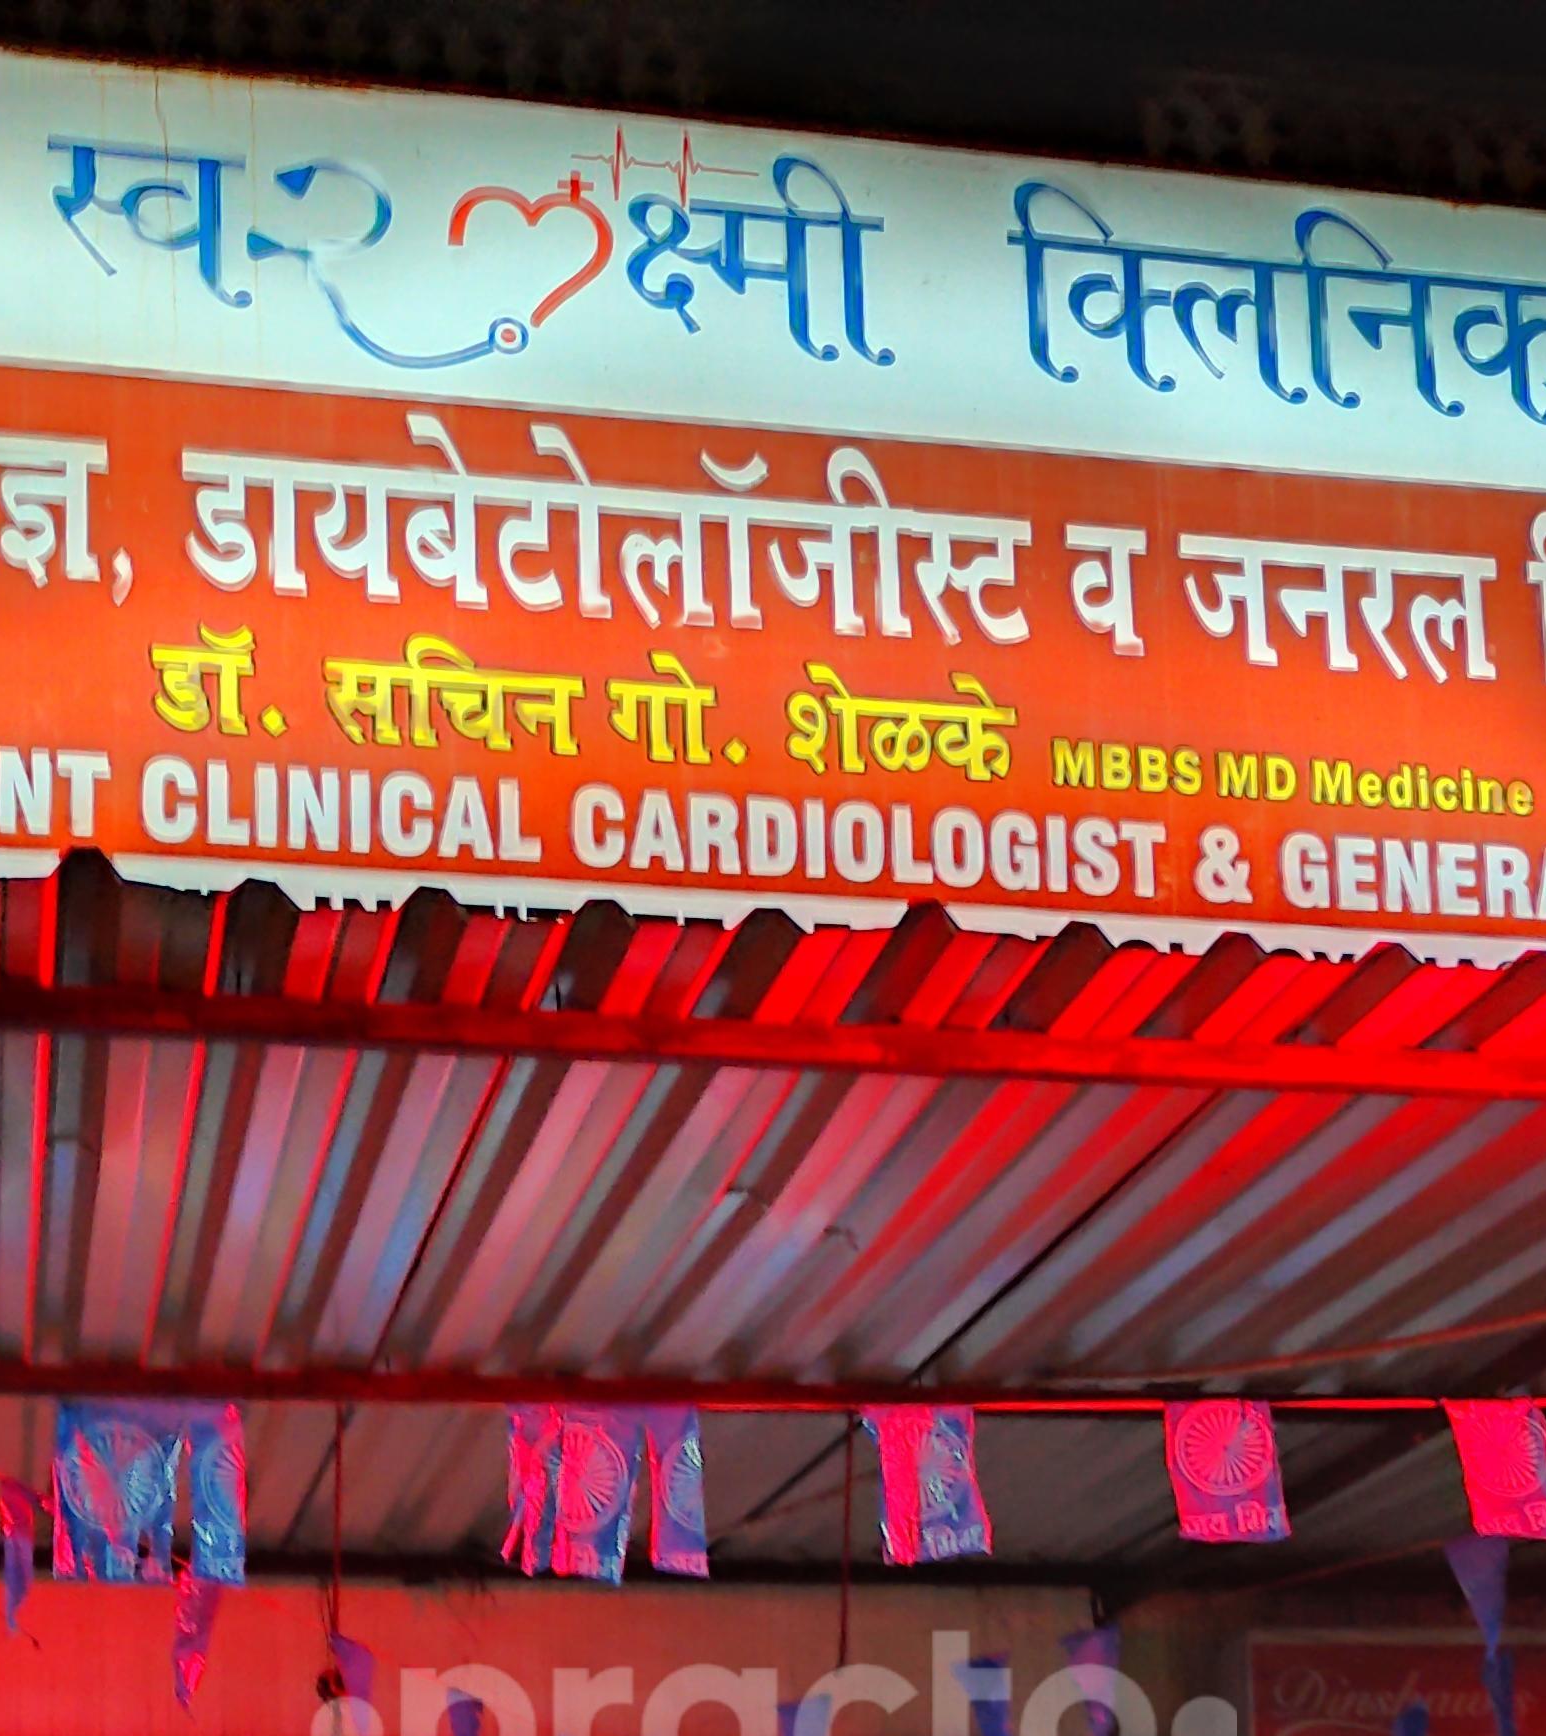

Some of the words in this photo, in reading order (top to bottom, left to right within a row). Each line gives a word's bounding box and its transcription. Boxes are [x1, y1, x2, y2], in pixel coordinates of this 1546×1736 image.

[1066, 525, 1145, 656] व
[1180, 534, 1496, 682] जनरल
[150, 622, 288, 738] डॉ.
[324, 632, 584, 756] सचिन
[607, 650, 748, 766] गो.
[786, 661, 1018, 783] शेळके
[1052, 737, 1202, 796] MBBS
[1216, 750, 1297, 801] MD
[1312, 760, 1535, 817] Medicine
[140, 757, 542, 865] CLINICAL
[572, 785, 1166, 900] CARDIOLOGIST
[1195, 824, 1254, 905] &
